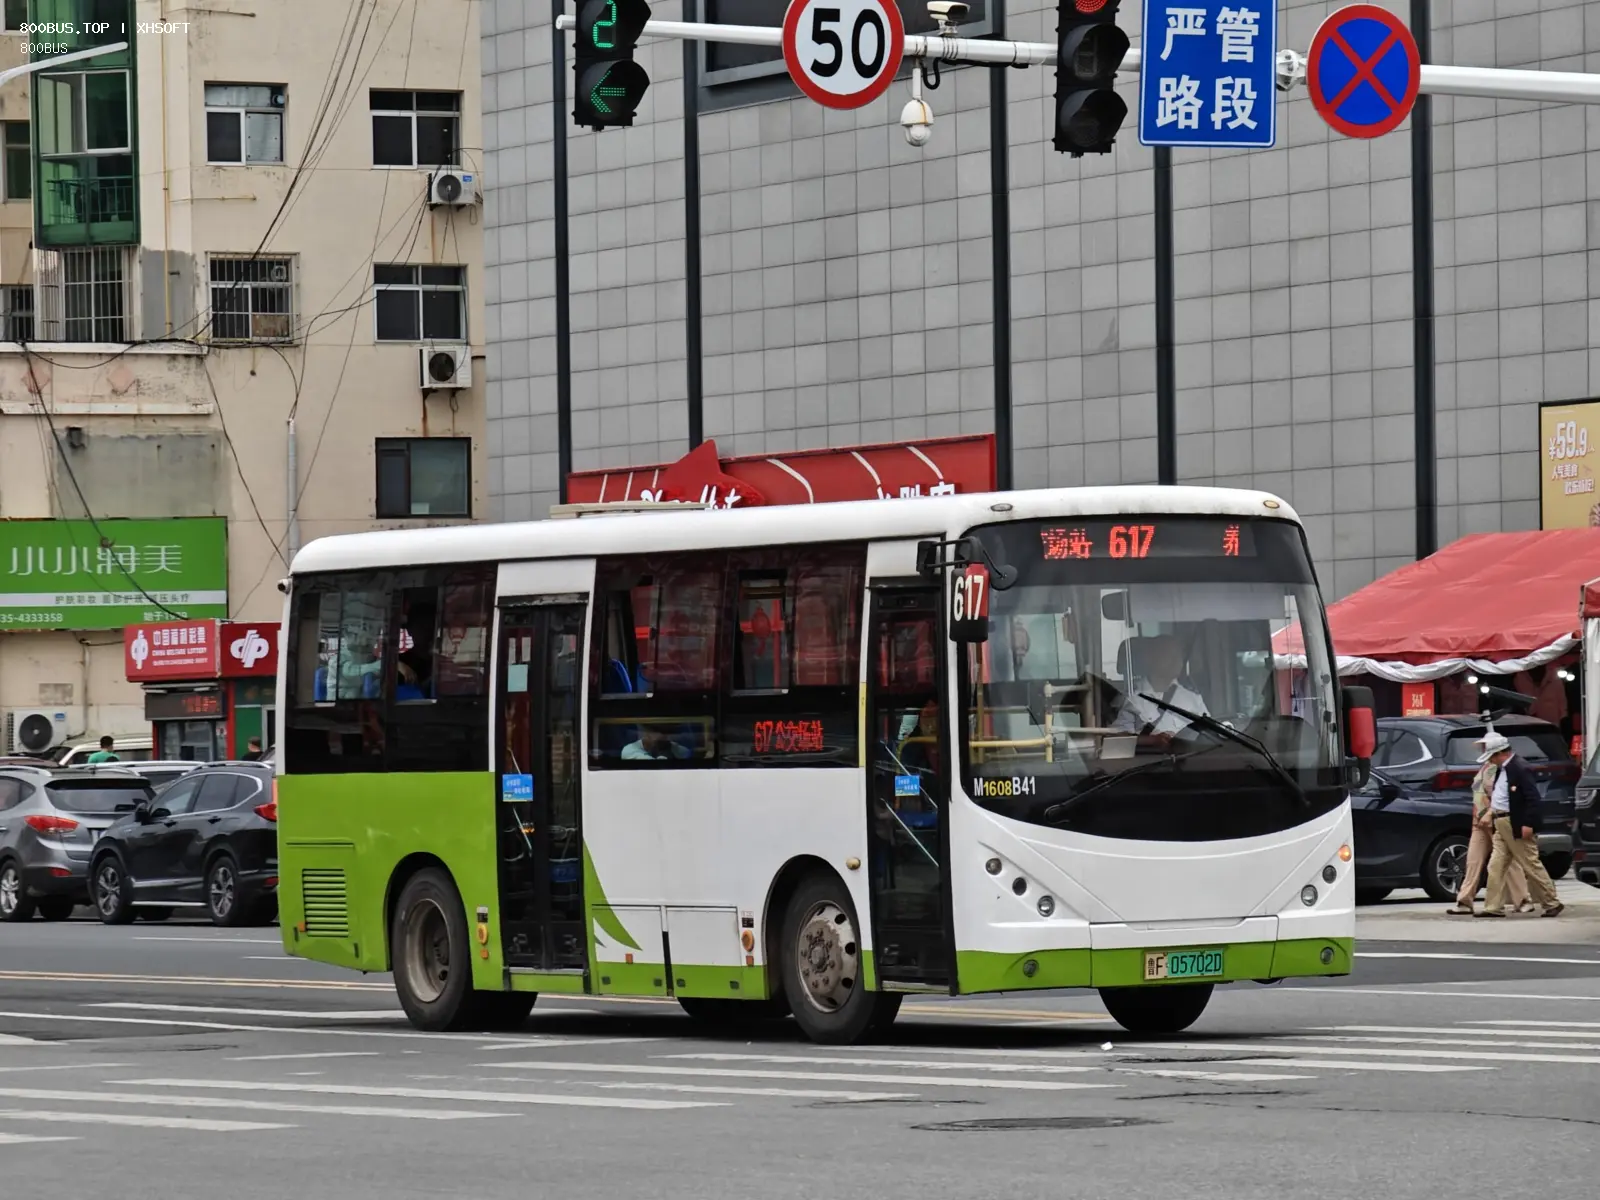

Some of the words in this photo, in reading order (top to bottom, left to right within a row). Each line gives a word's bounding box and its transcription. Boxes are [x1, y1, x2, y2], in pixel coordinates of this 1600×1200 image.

[592, 0, 617, 48] 2
[810, 8, 886, 79] 50
[1160, 7, 1260, 64] 严管
[1155, 75, 1258, 130] 路段
[1109, 525, 1155, 559] 617
[953, 574, 985, 622] 617
[974, 775, 1036, 797] M1608B41
